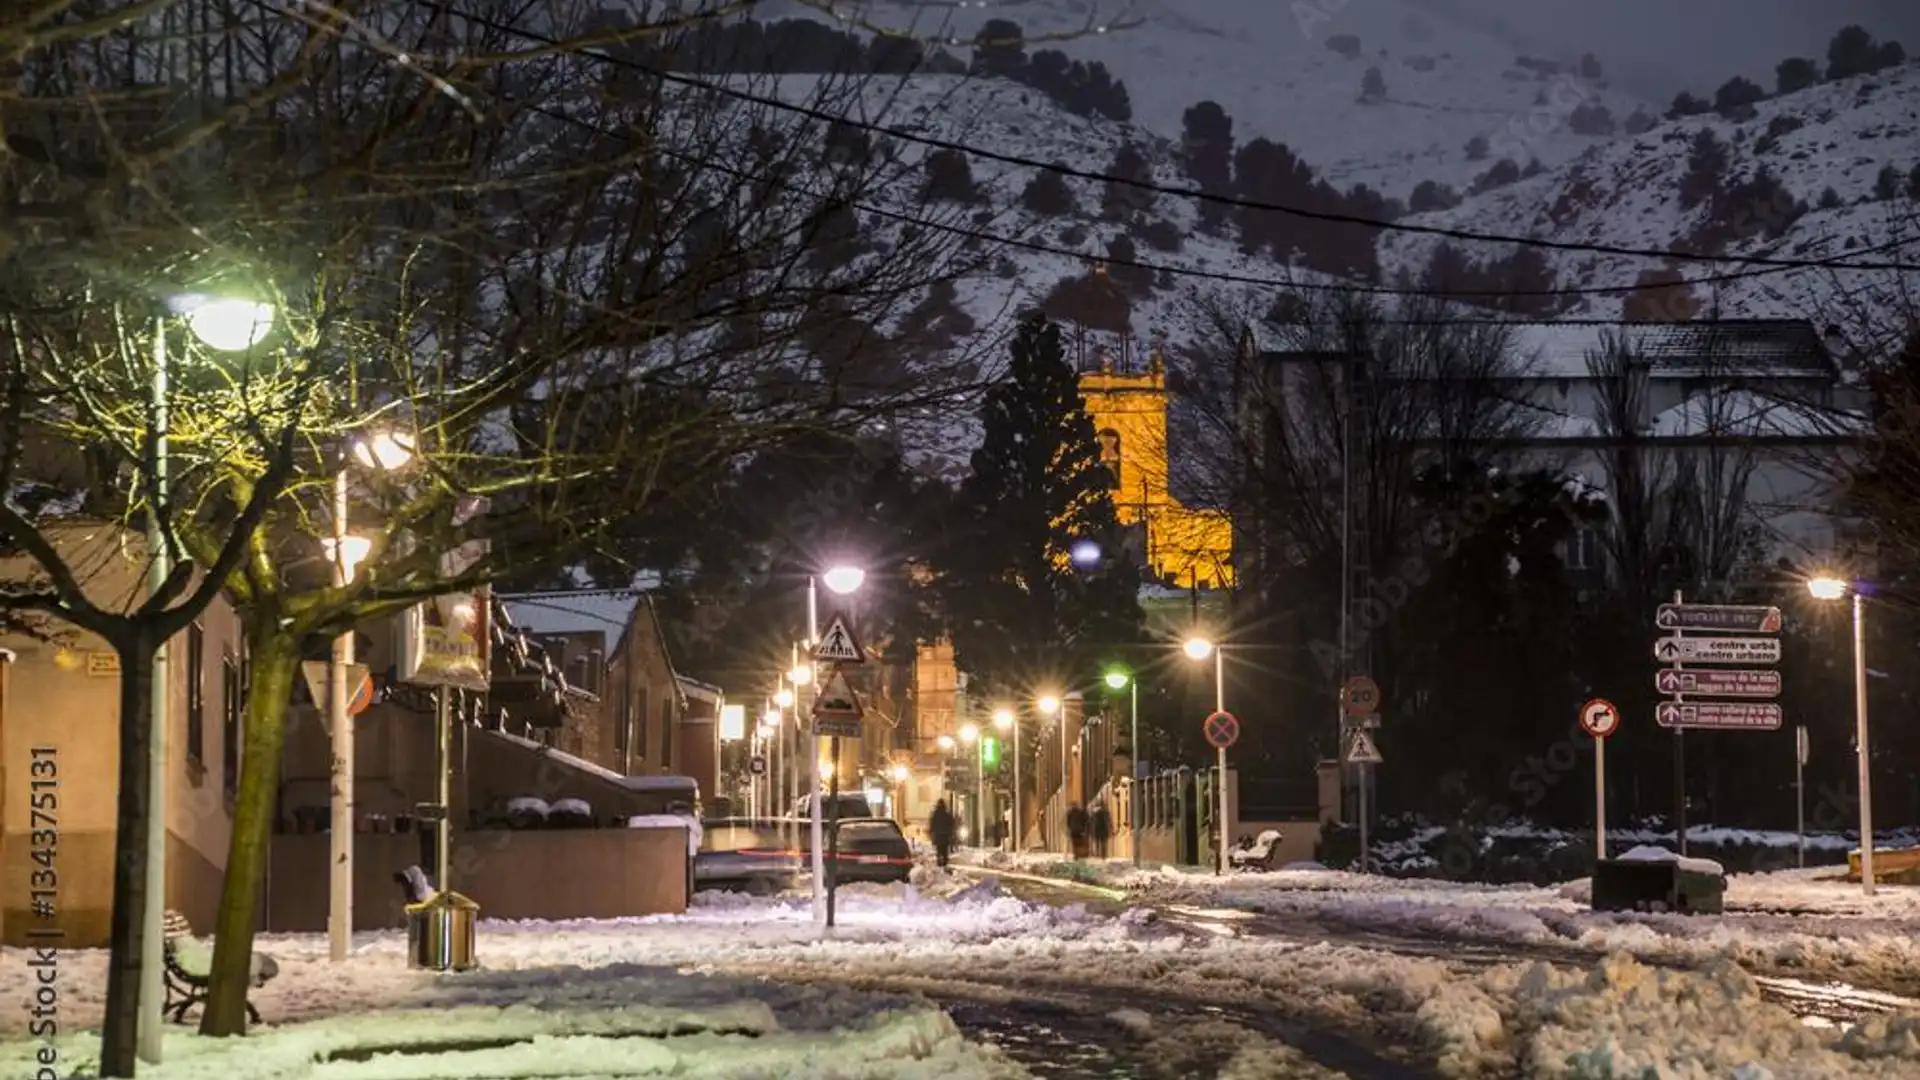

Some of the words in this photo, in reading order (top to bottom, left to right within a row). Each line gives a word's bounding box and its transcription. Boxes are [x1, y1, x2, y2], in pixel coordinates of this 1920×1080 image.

[1709, 641, 1746, 650] centre
[1696, 650, 1733, 659] centro
[1736, 650, 1776, 660] urbano
